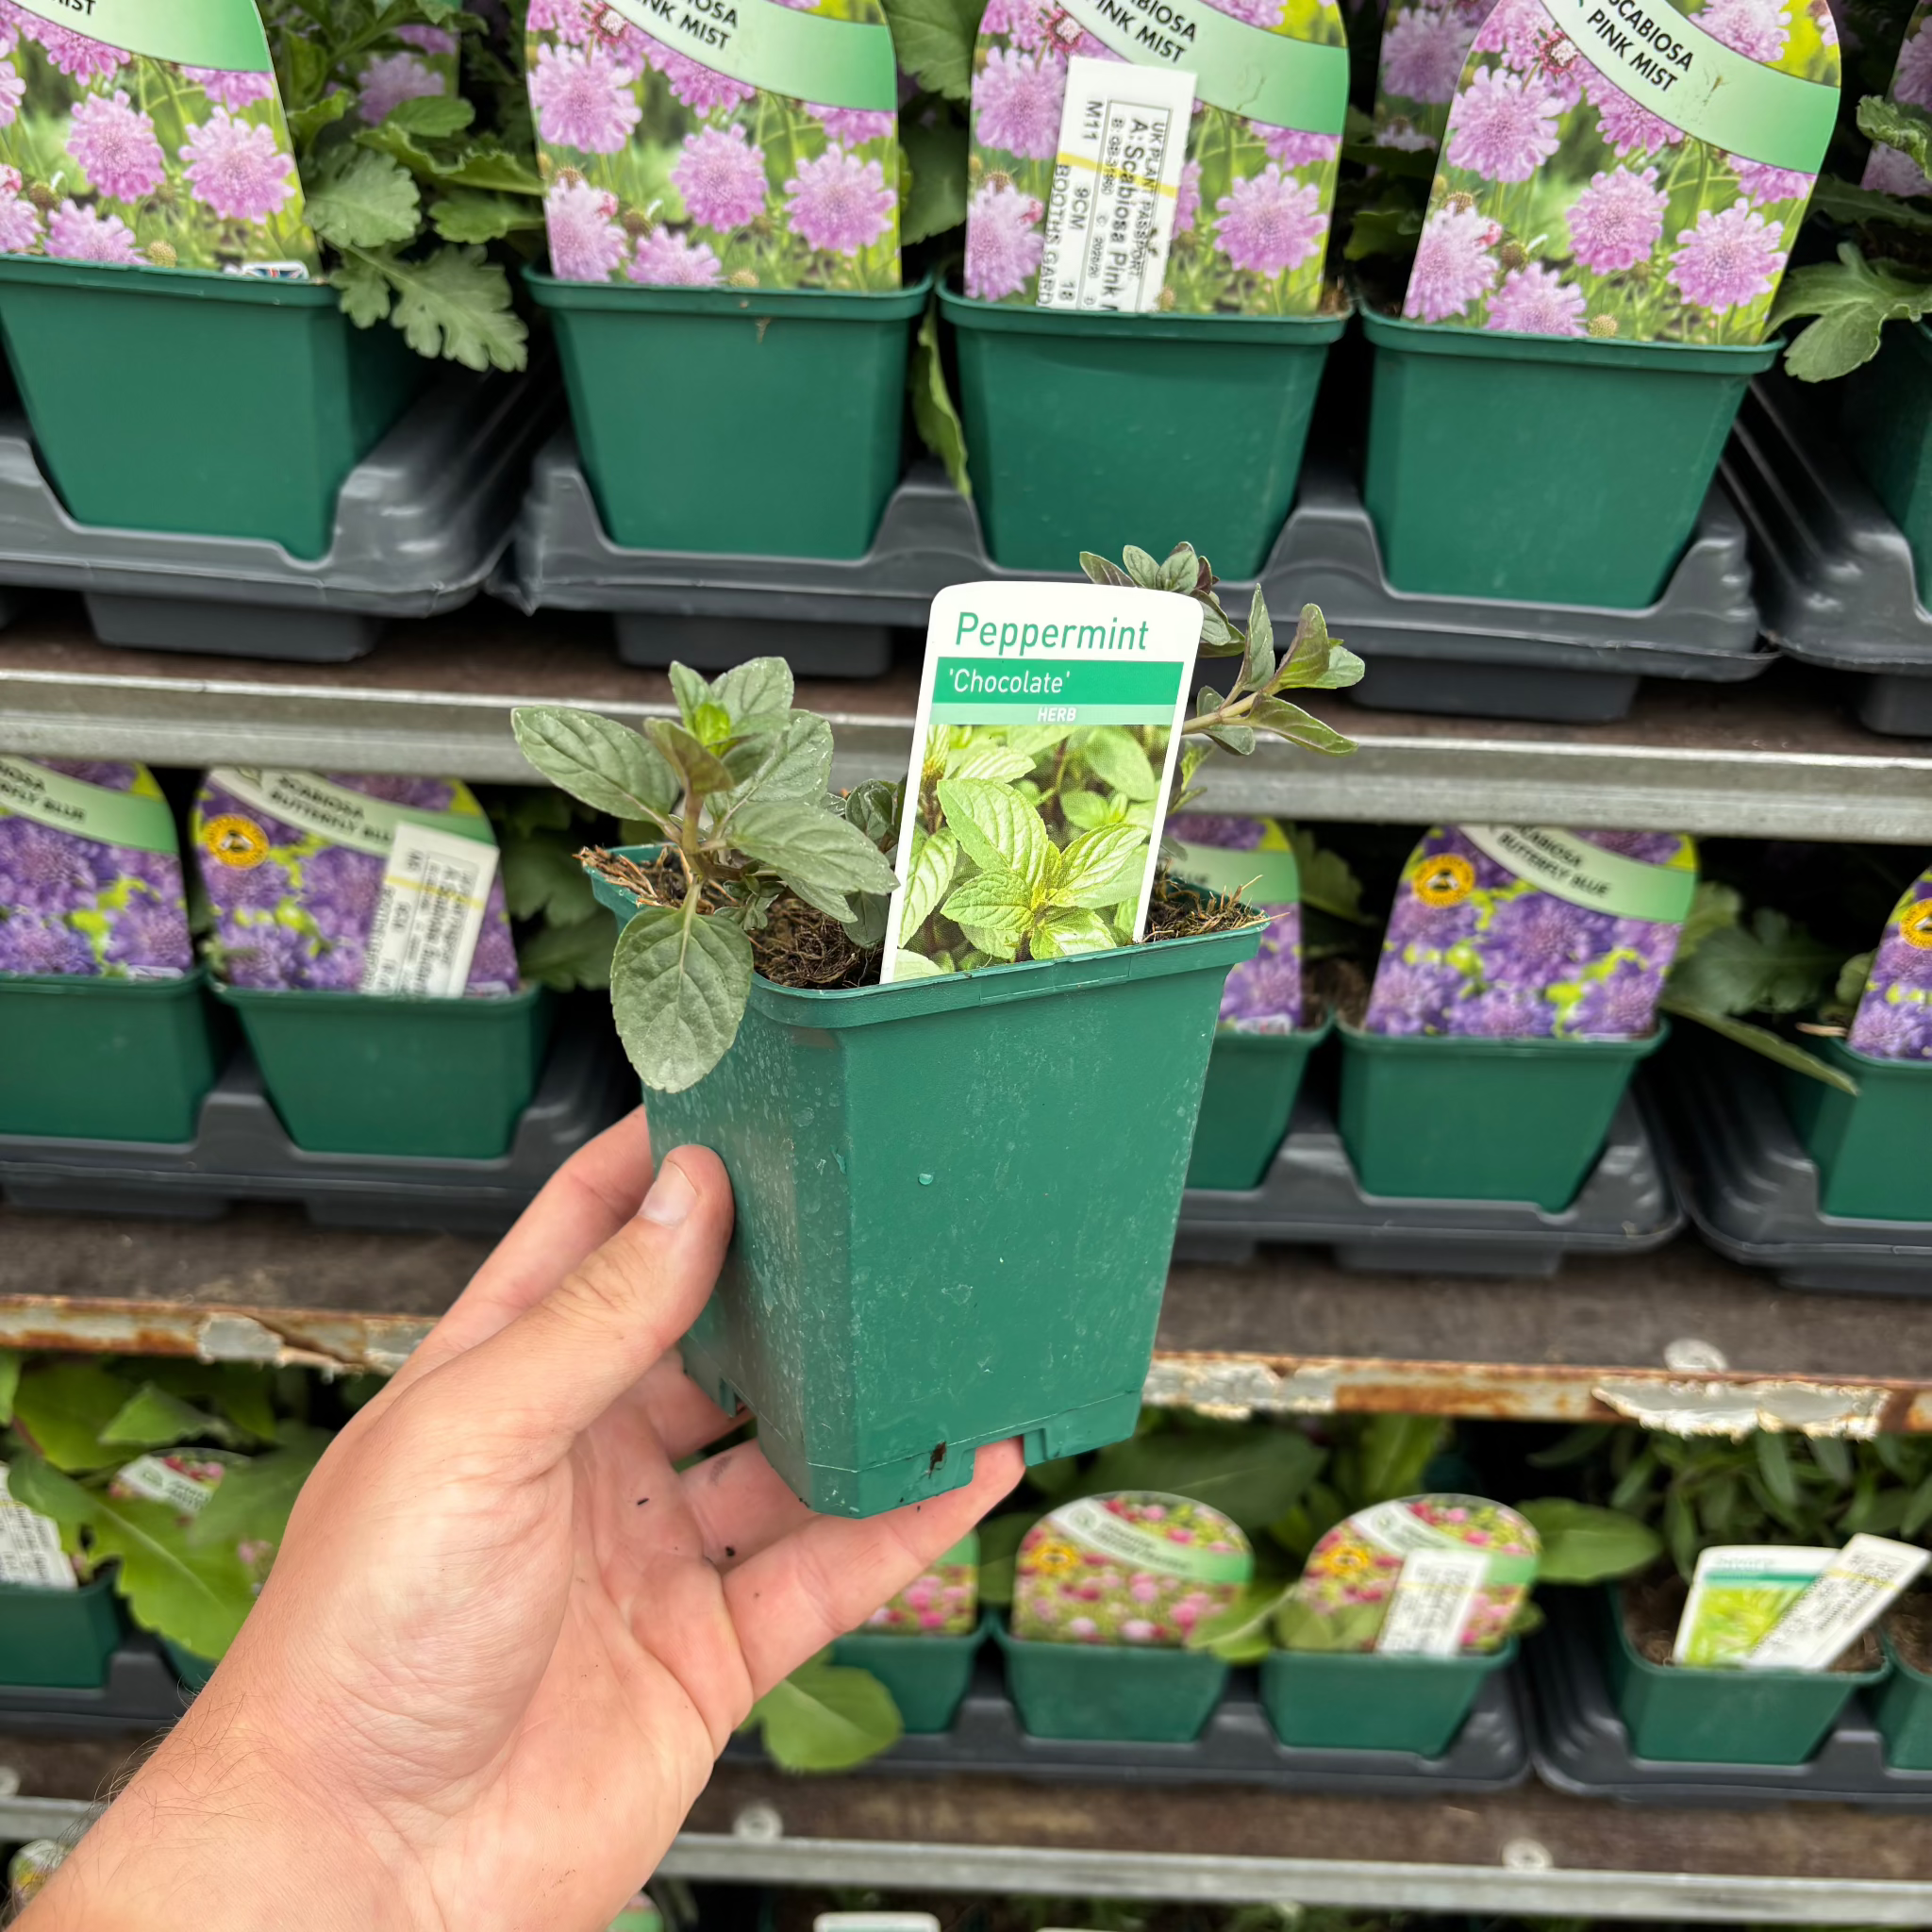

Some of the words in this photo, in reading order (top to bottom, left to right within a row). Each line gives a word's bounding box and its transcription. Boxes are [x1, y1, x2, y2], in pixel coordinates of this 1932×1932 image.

[679, 14, 730, 49] MIST
[1135, 25, 1187, 63] MIST
[1587, 8, 1635, 58] PINK
[1629, 52, 1678, 92] MIST
[1082, 100, 1103, 141] M11
[1148, 122, 1165, 143] UK
[1142, 147, 1160, 196] PLANT
[1045, 164, 1071, 245] BOOTHS
[1070, 187, 1090, 230] 9CM
[1110, 145, 1144, 244] Scabiosa
[1128, 200, 1152, 277] PASSPORT
[1103, 251, 1128, 297] Pink
[955, 611, 1149, 656] Peppermint
[948, 668, 1071, 693] 'Chocolate'
[1037, 708, 1076, 722] HERB
